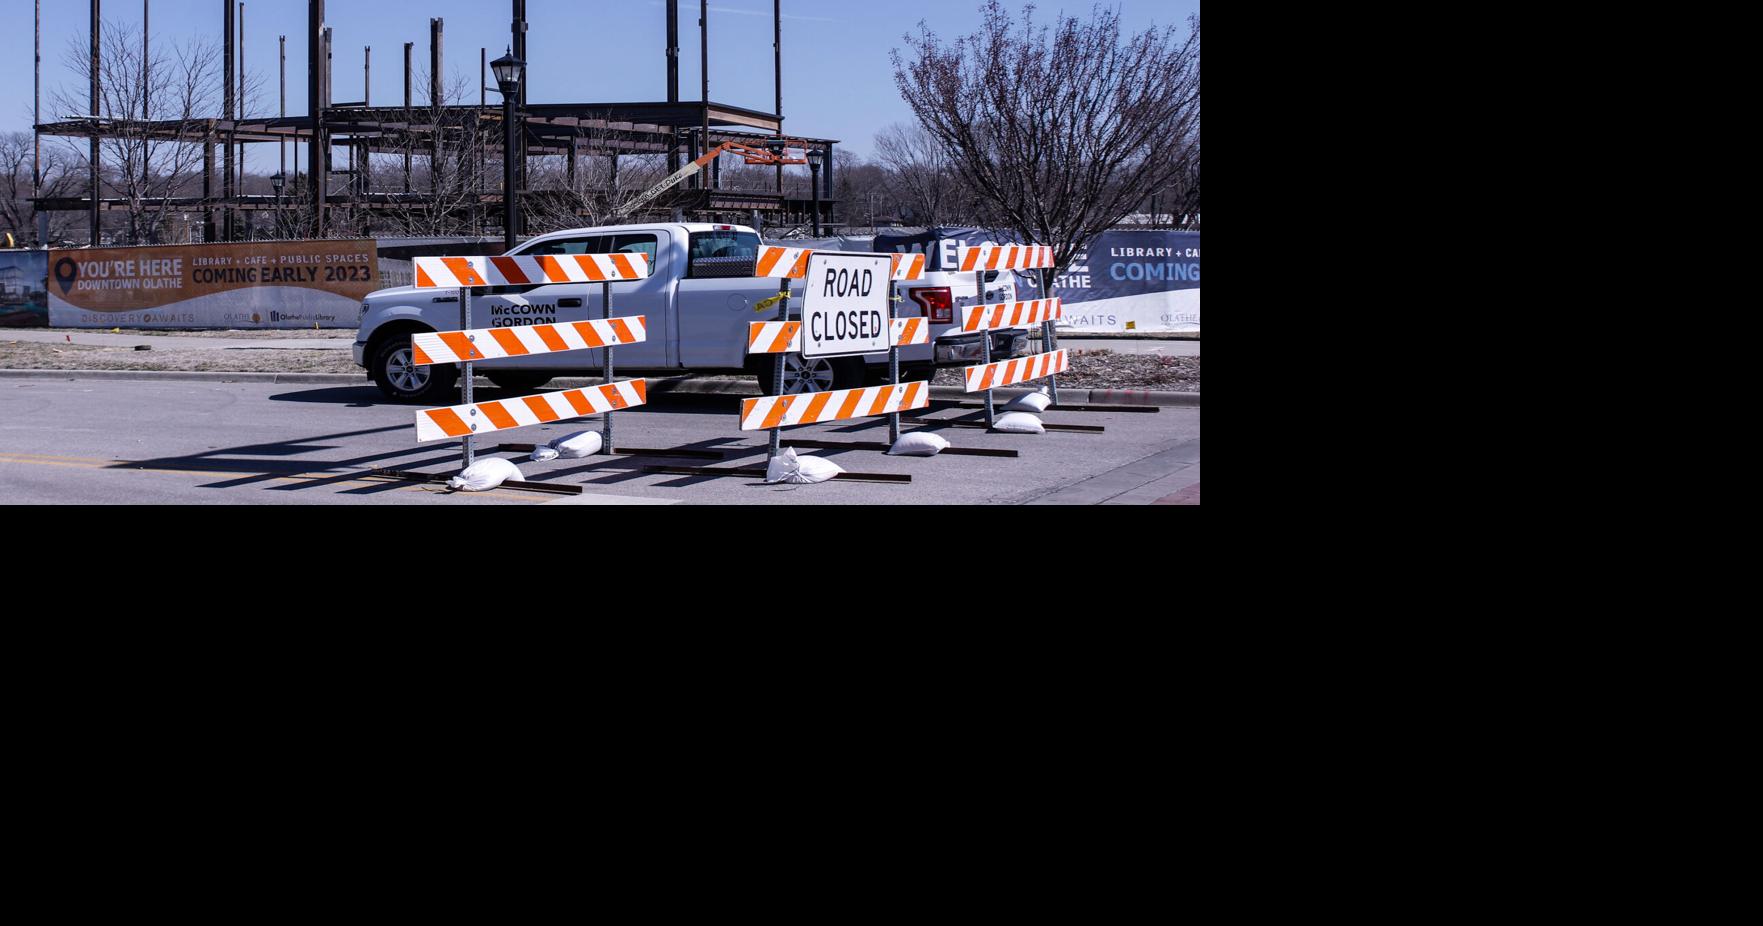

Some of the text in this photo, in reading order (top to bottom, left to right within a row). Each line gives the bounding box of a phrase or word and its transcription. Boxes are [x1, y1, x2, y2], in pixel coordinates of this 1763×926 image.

[192, 257, 232, 266] LIBRARY
[244, 256, 267, 265] CAFE
[280, 255, 321, 264] PUBLIC
[326, 253, 369, 263] SPACES
[1110, 247, 1172, 257] LIBRARY
[78, 258, 183, 278] YOU'RE HERE
[192, 265, 371, 284] COMING EARLY 2023
[1109, 262, 1200, 281] COMING
[77, 277, 183, 290] DOWNTOWN OLATHE
[823, 268, 873, 297] ROAD
[491, 304, 556, 315] McCOWN
[81, 313, 194, 323] DISCOVERY AWAITS
[811, 310, 881, 341] CLOSED
